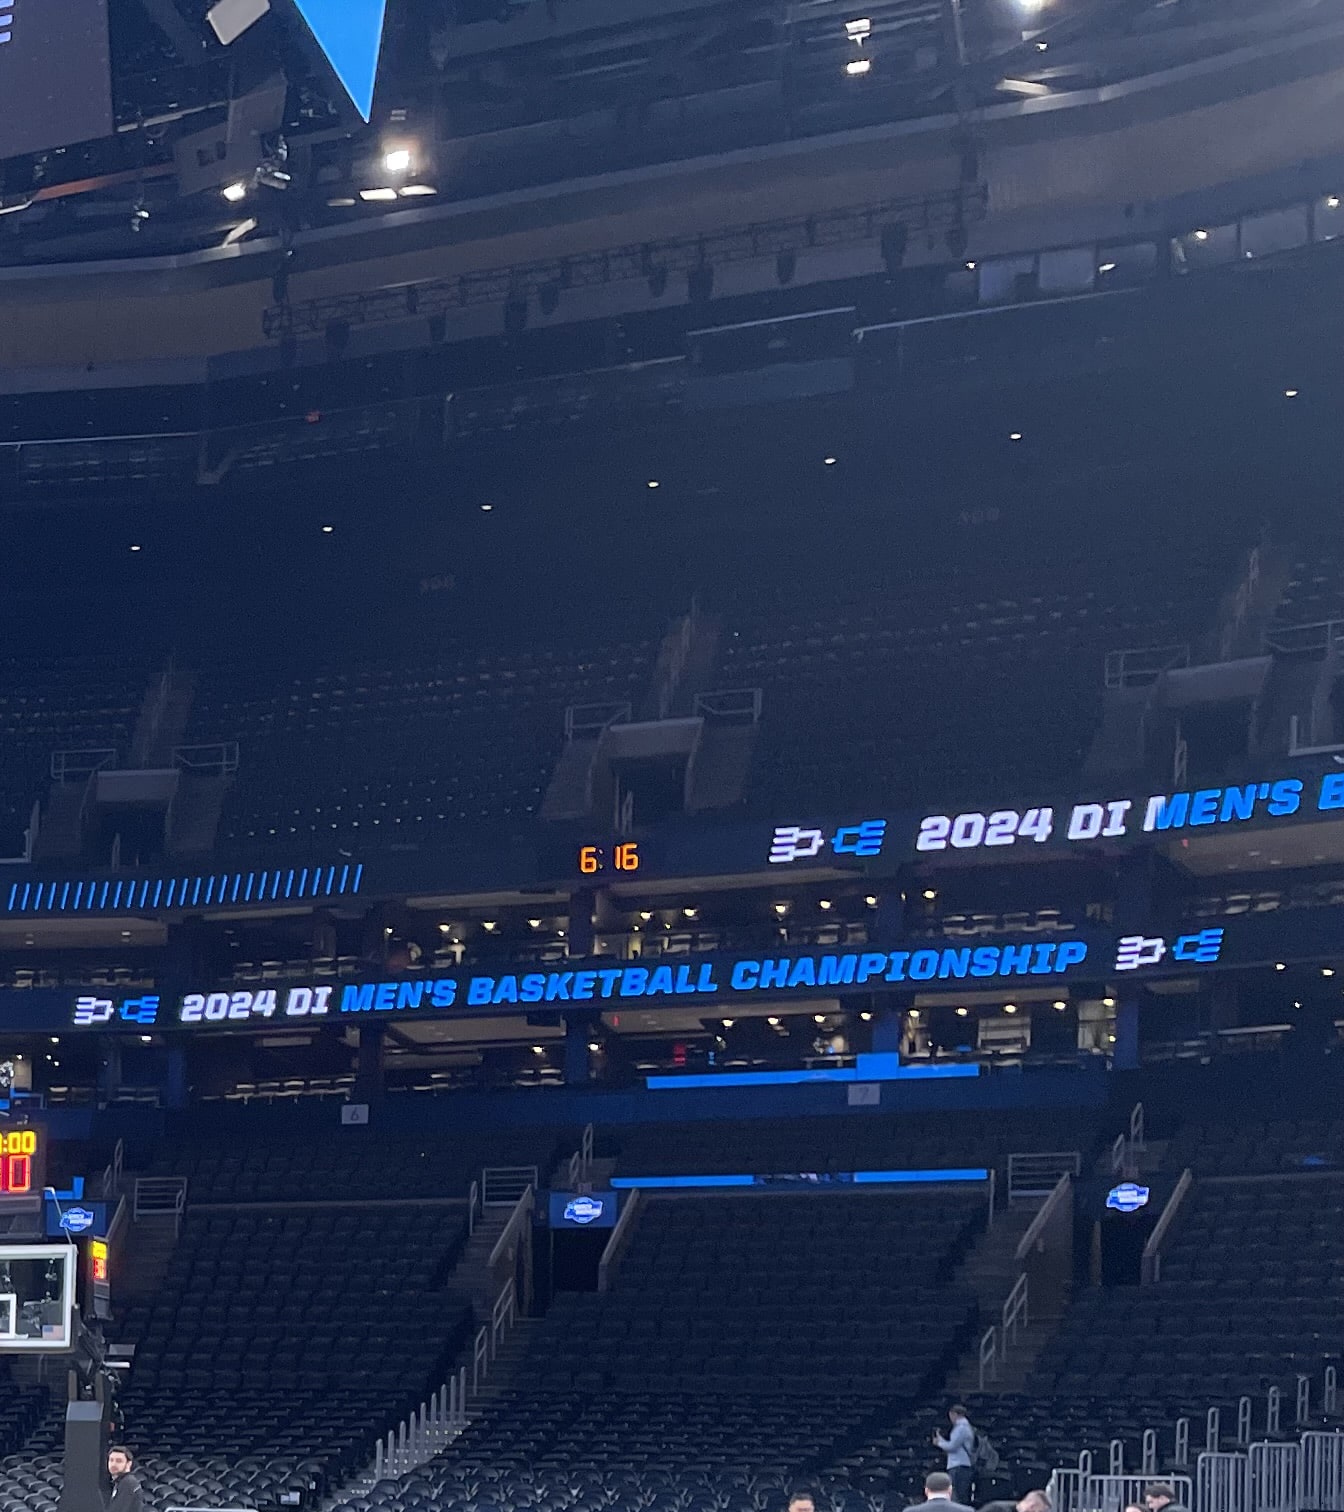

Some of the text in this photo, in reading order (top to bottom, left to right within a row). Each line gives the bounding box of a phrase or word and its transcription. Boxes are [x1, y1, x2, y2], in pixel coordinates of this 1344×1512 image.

[917, 806, 1054, 852] 2024
[1068, 801, 1131, 840] DI
[1143, 778, 1303, 835] MEN'S
[180, 940, 1088, 1023] 2024 DI MEN'S BASKETBALL CHAMPIONSHIP
[350, 1106, 359, 1121] 6
